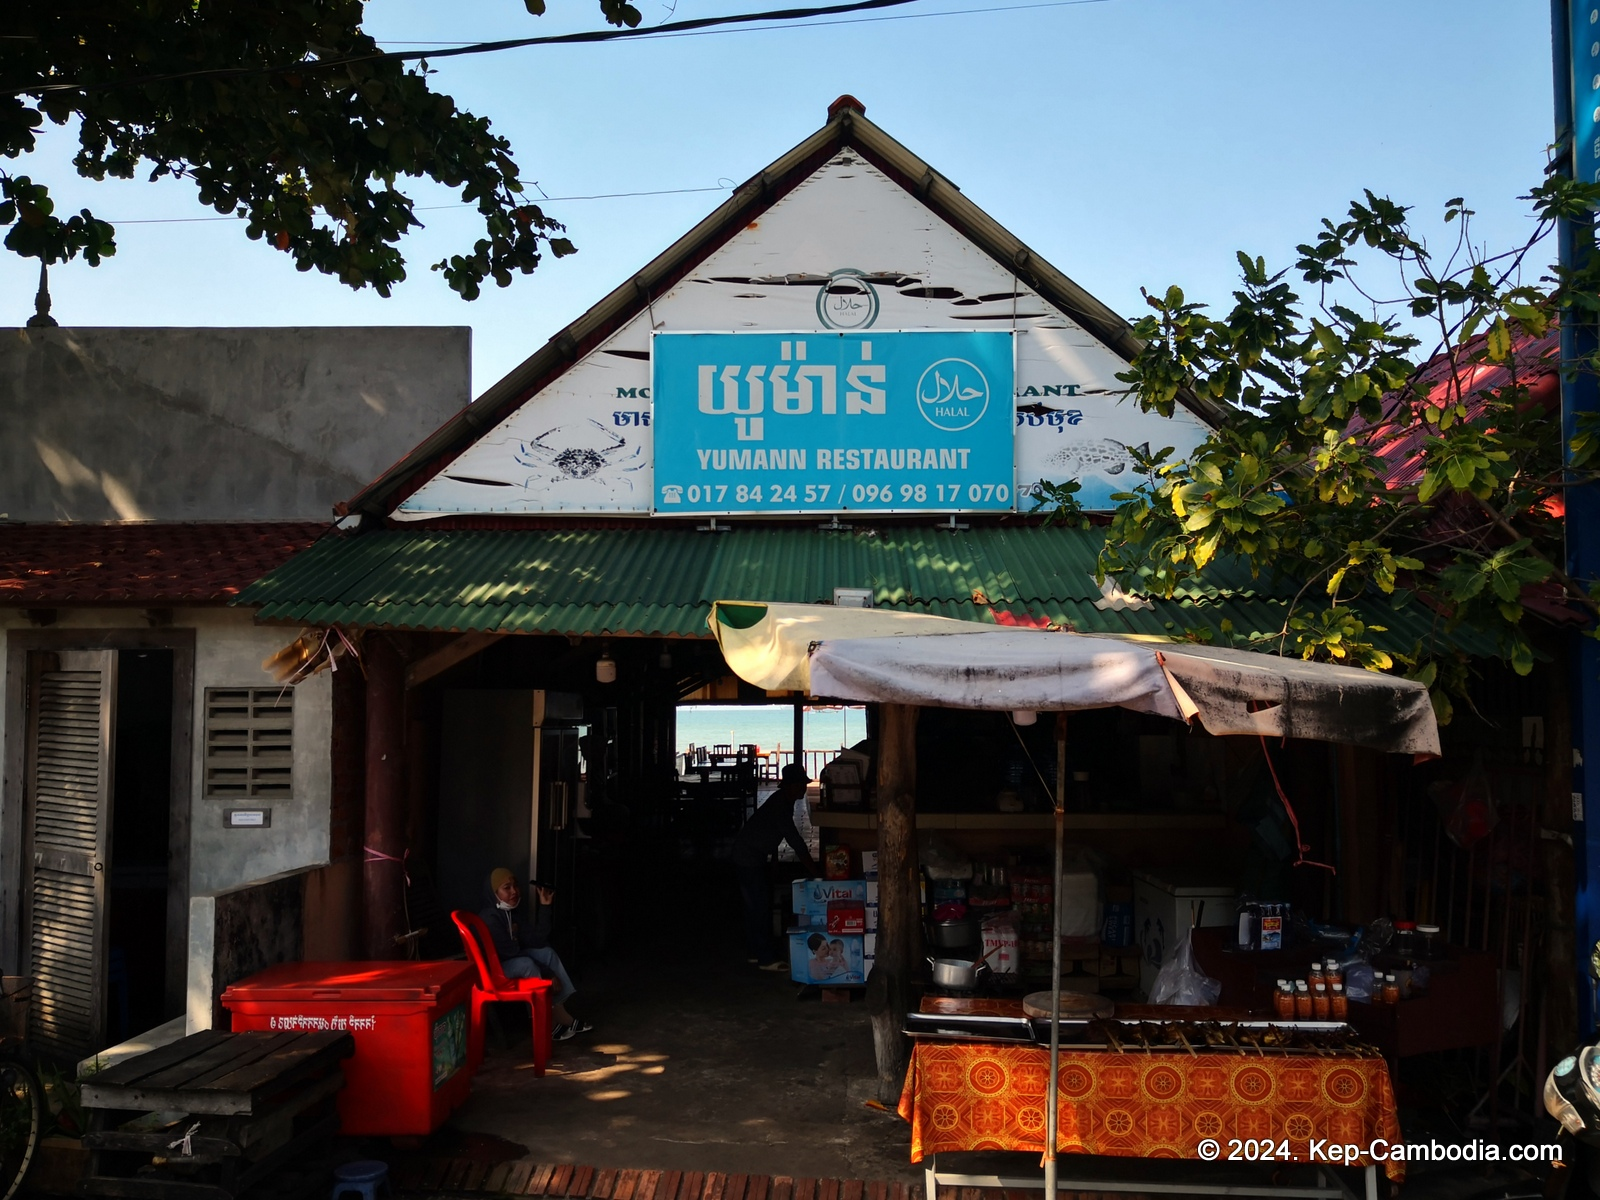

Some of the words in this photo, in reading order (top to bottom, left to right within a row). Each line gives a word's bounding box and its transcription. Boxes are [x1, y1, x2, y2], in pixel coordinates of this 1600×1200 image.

[833, 296, 863, 310] حلال
[698, 341, 886, 441] យូម៉ាន់
[921, 370, 984, 404] حلال
[935, 407, 970, 417] HALAL
[697, 449, 807, 470] YUMANN
[816, 448, 971, 470] RESTAURANT
[687, 484, 729, 503] 017
[735, 484, 763, 503] 84
[769, 484, 798, 503] 24
[803, 484, 831, 503] 57
[852, 484, 893, 503] 096
[900, 484, 927, 503] 98
[936, 484, 961, 503] 17
[968, 484, 1009, 503] 070
[822, 886, 852, 899] Vital
